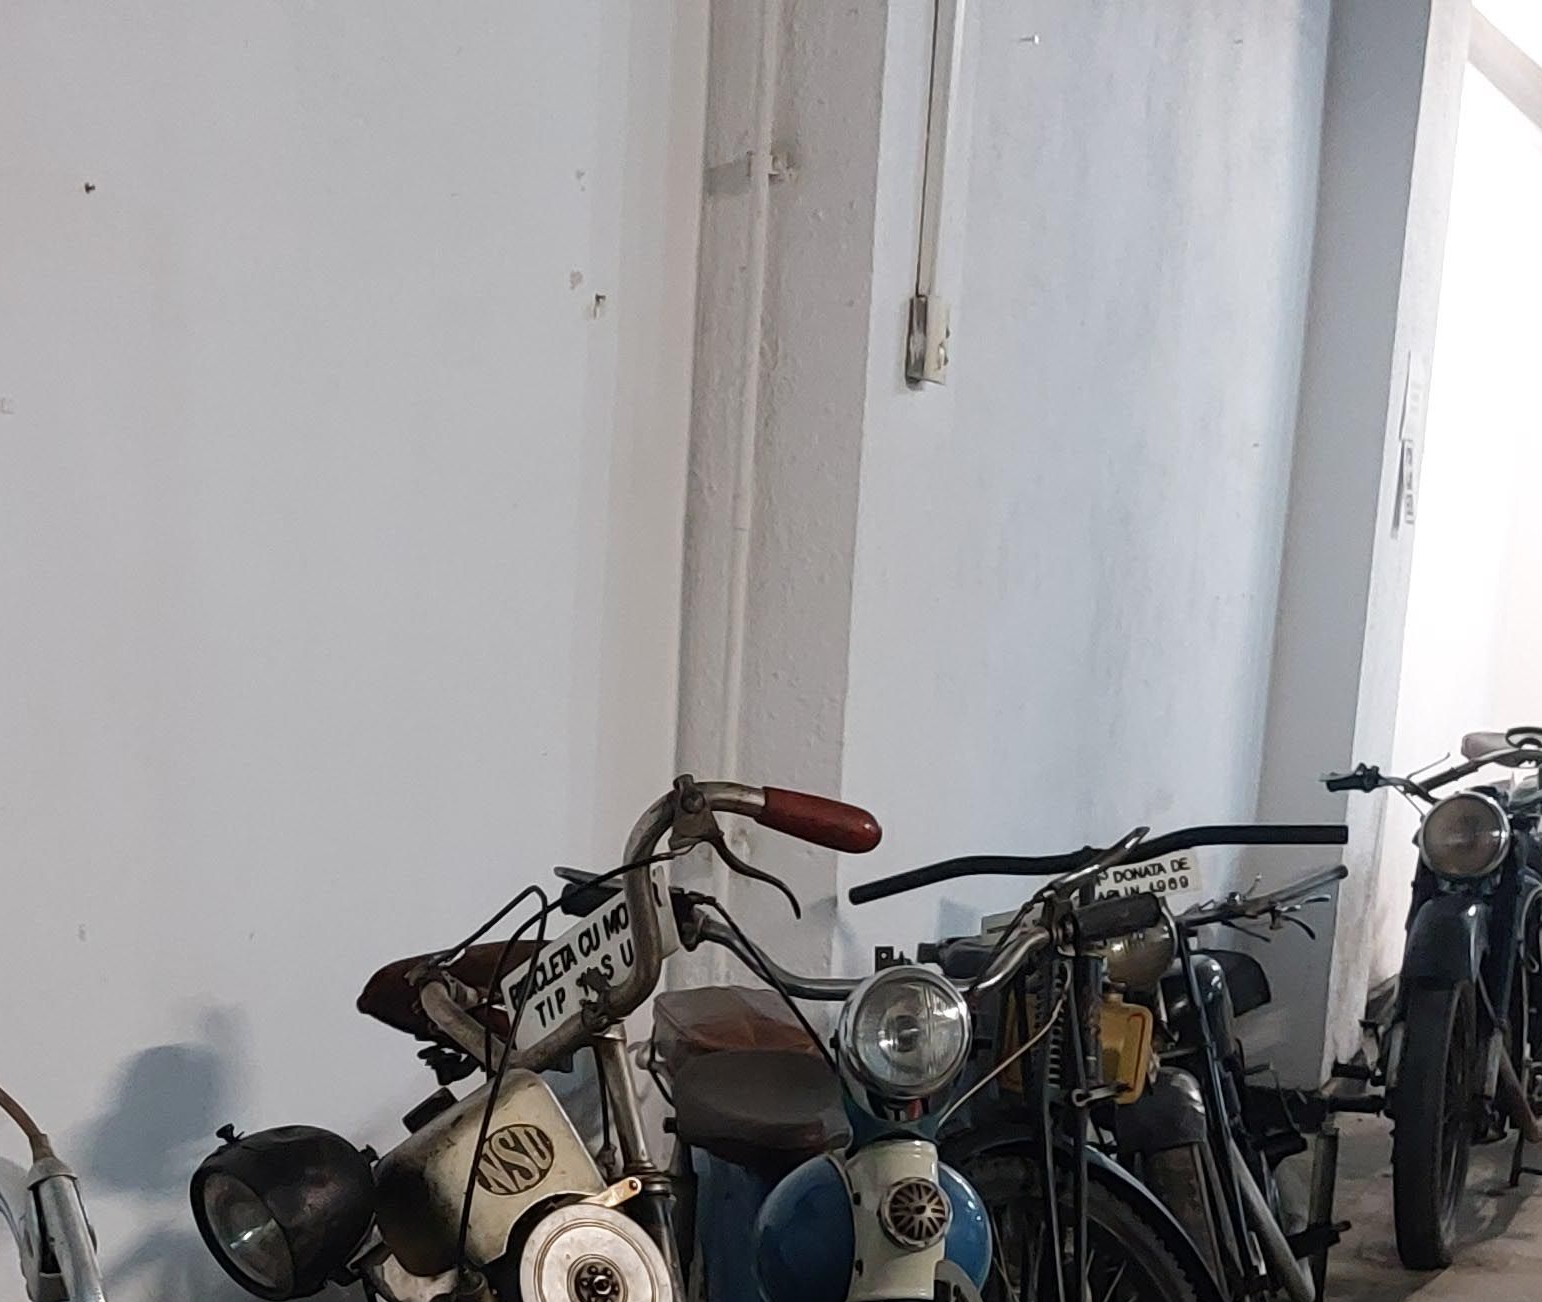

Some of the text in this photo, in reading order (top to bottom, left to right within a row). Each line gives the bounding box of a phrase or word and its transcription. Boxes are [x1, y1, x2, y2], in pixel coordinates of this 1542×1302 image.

[1112, 862, 1167, 884] DONATA
[1170, 856, 1191, 873] DE
[577, 922, 601, 959] CU
[534, 986, 567, 1029] TIP
[477, 1126, 553, 1195] NSU
